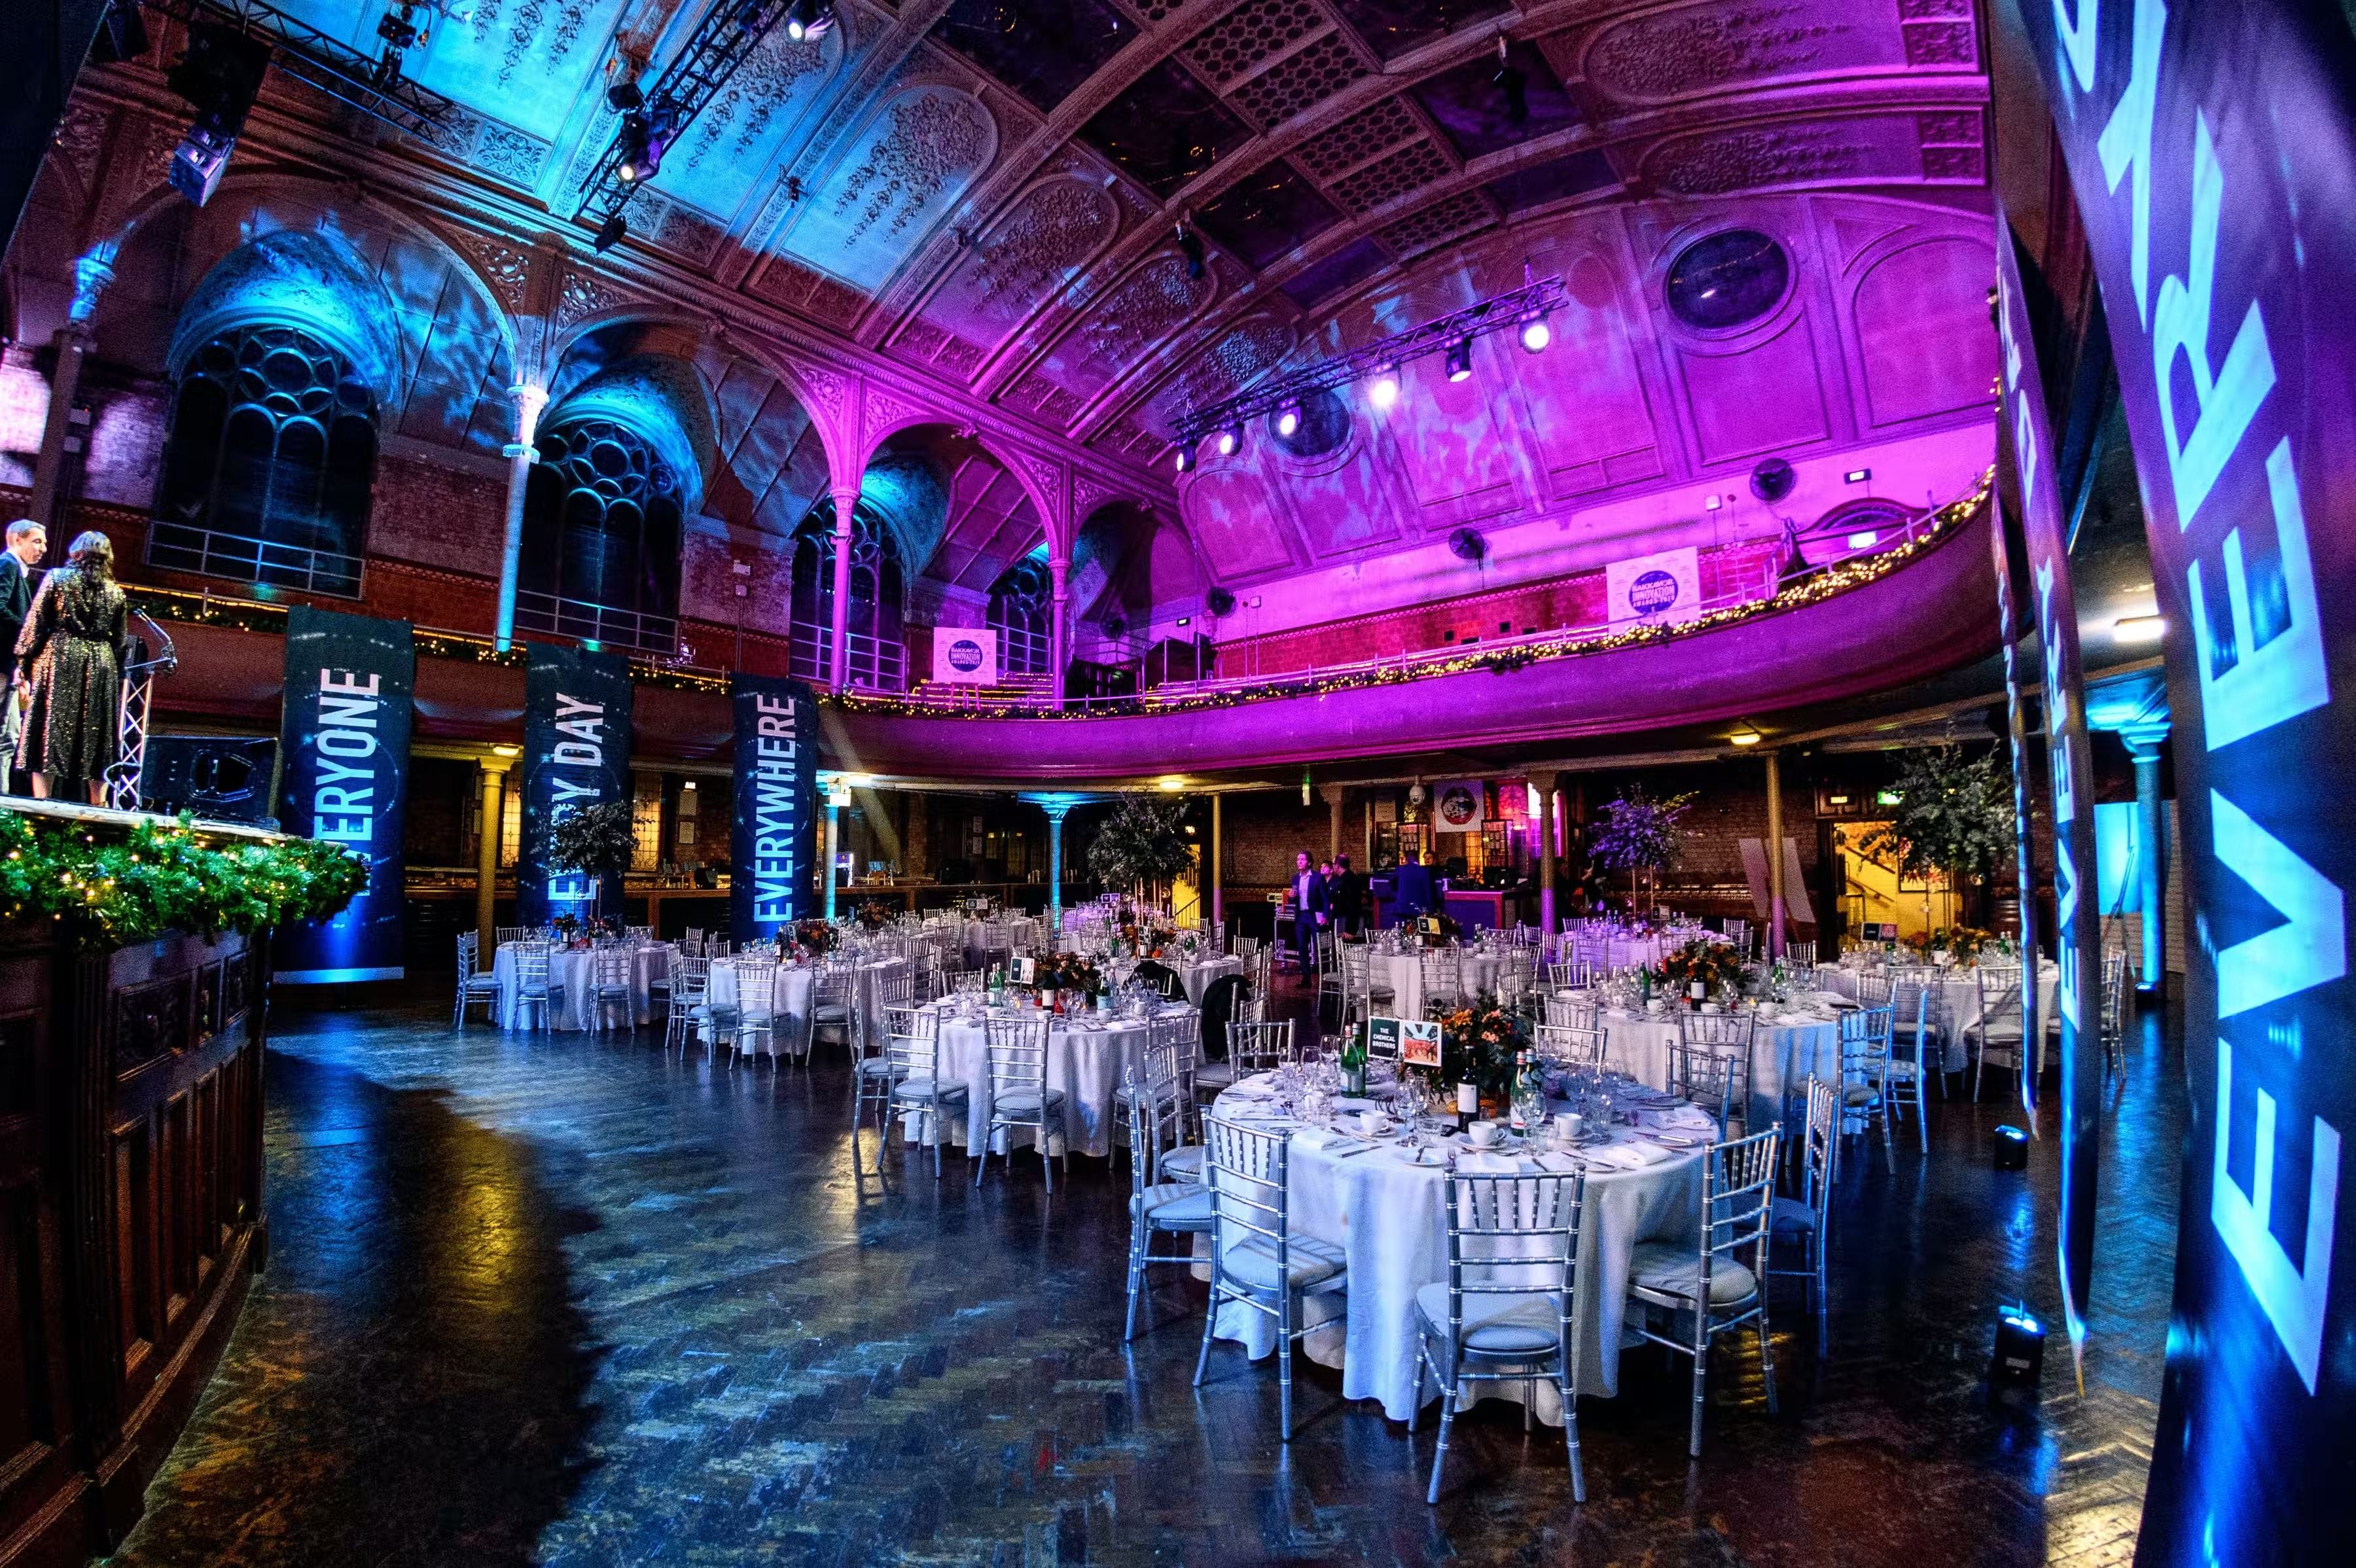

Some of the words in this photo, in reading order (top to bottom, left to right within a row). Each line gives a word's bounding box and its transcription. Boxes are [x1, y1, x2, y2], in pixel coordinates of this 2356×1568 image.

[1632, 585, 1675, 602] INNOVATION
[951, 652, 980, 661] INNOVATION
[554, 692, 603, 766] DAY
[314, 668, 380, 896] ERYONE
[754, 694, 796, 921] EVERYWHERE
[1372, 1041, 1395, 1049] BROTHERS
